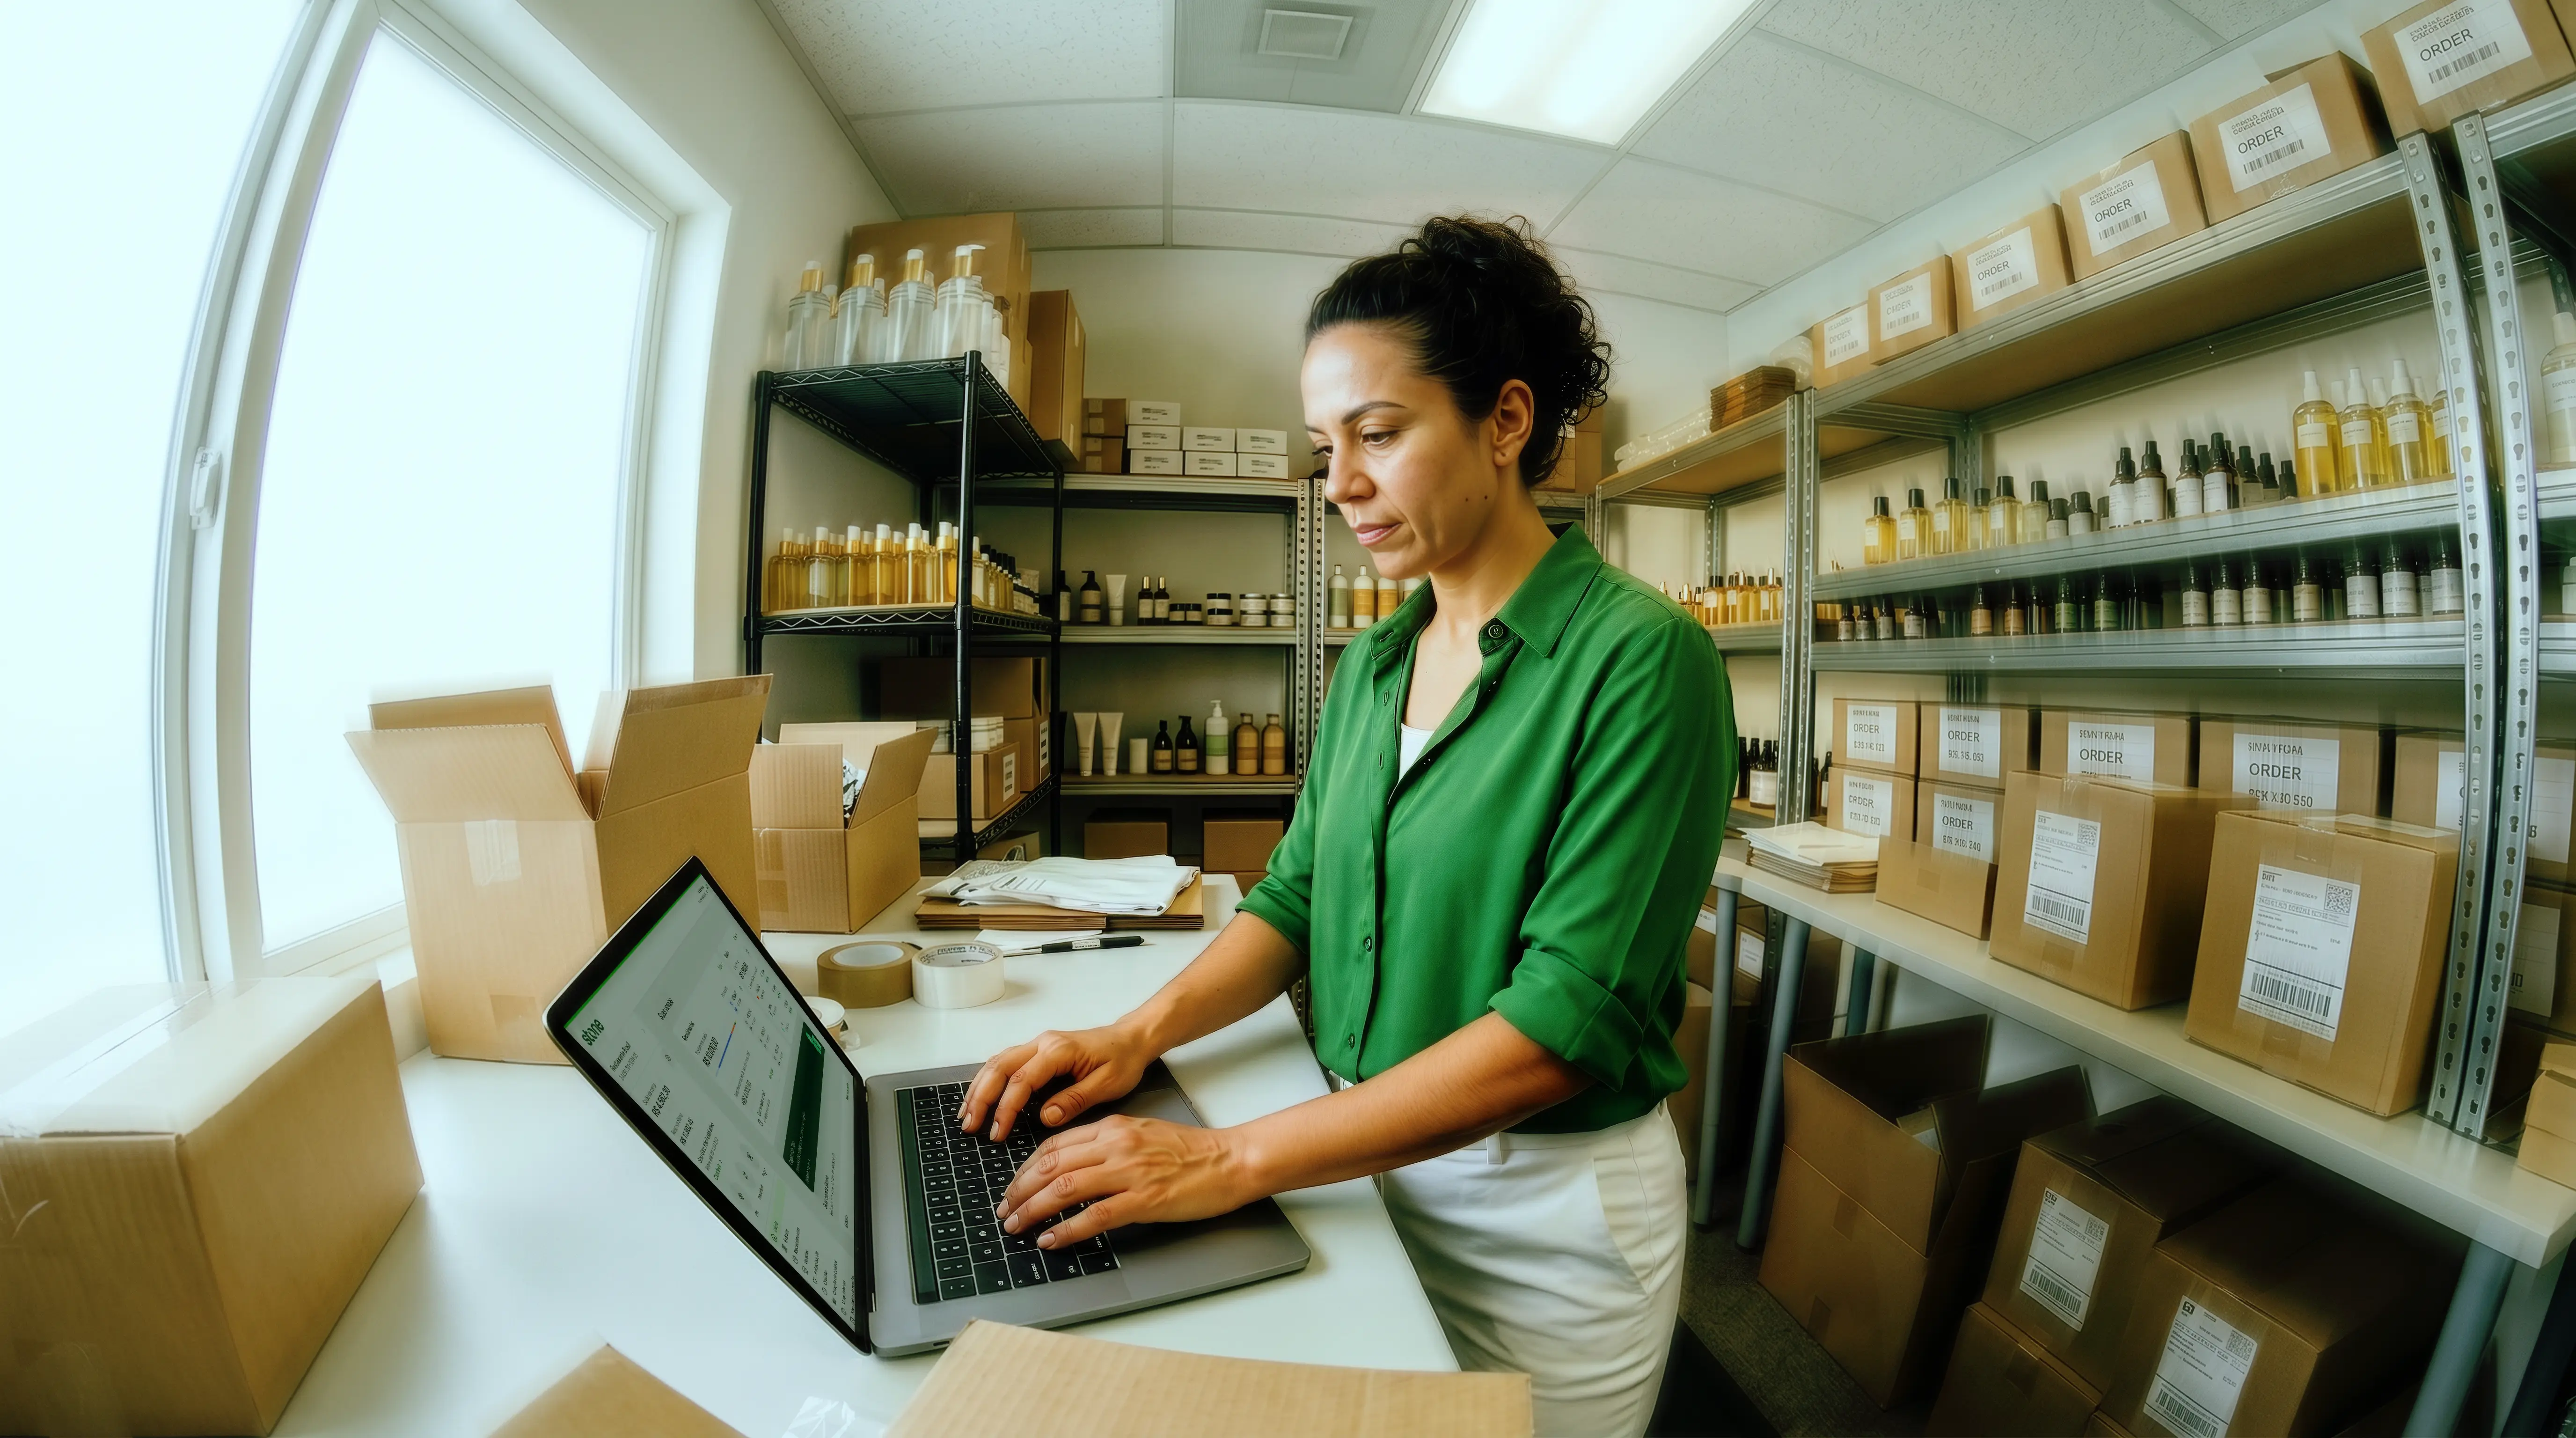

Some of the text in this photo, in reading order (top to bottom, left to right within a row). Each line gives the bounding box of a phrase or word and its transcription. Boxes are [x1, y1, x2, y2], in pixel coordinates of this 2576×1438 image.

[2420, 28, 2473, 62] ORDER
[2238, 125, 2284, 154] ORDER
[2095, 198, 2132, 222] ORDER
[1978, 260, 2010, 280] ORDER
[1853, 724, 1879, 734] ORDER
[1948, 731, 1980, 742] ORDER
[2080, 748, 2123, 764] ORDER
[2249, 763, 2301, 781] ORDER
[1942, 816, 1973, 830] ORDER
[658, 998, 673, 1020] Suas vendas
[582, 1020, 604, 1045] stone
[609, 1042, 631, 1071] Restaurante Brasil
[705, 1037, 718, 1060] 10.000,00
[651, 1085, 670, 1117] R$ 4.562,30
[680, 1136, 686, 1145] R$
